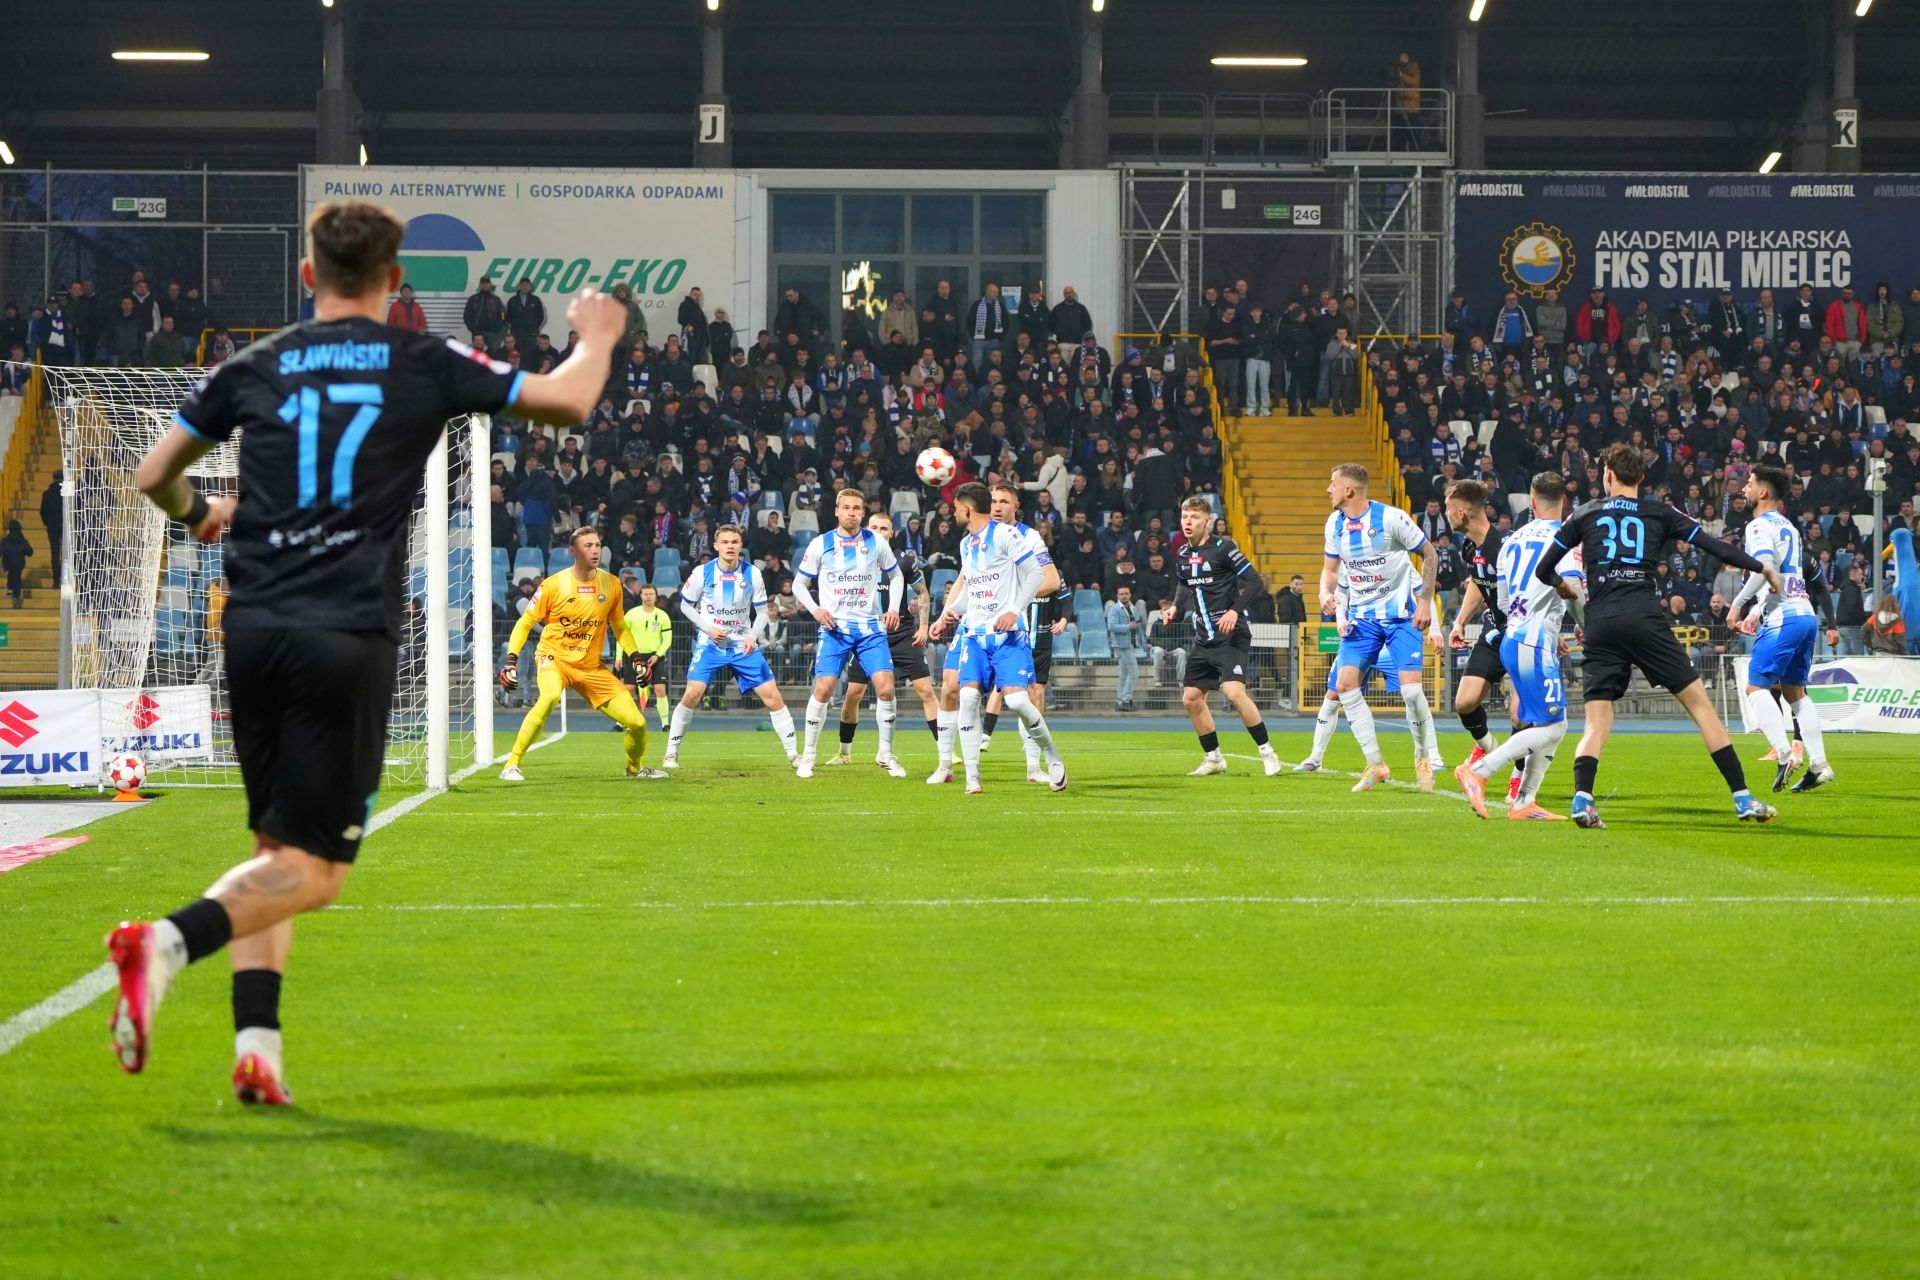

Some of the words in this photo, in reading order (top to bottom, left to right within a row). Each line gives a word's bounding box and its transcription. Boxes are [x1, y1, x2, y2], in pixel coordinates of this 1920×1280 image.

[704, 116, 717, 140] J
[1836, 121, 1854, 144] K
[324, 182, 383, 195] PALIWO
[390, 184, 506, 197] ALTERNATYWNE
[530, 185, 635, 198] GOSPODARKA
[642, 186, 724, 199] ODPADAMI
[1459, 184, 1525, 197] #MŁODASTAL
[1624, 185, 1690, 198] #MŁODASTAL
[1790, 185, 1856, 197] #MŁODASTAL
[140, 202, 165, 213] 23G
[1295, 209, 1320, 220] 24G
[1595, 231, 1720, 249] AKADEMIA
[1726, 230, 1851, 249] PIŁKARSKA
[476, 258, 688, 295] EURO-EKO
[1595, 251, 1649, 289] FKS
[1659, 251, 1731, 289] STAL
[1741, 250, 1851, 288] MIELEC
[278, 339, 391, 375] SŁAWIŃSKI
[277, 383, 385, 510] 17
[1597, 516, 1645, 565] 39
[1348, 556, 1387, 569] efectivo
[1506, 541, 1545, 595] 27
[838, 573, 872, 582] efectivo
[1543, 678, 1562, 702] 27
[0, 751, 89, 775] ZUKI
